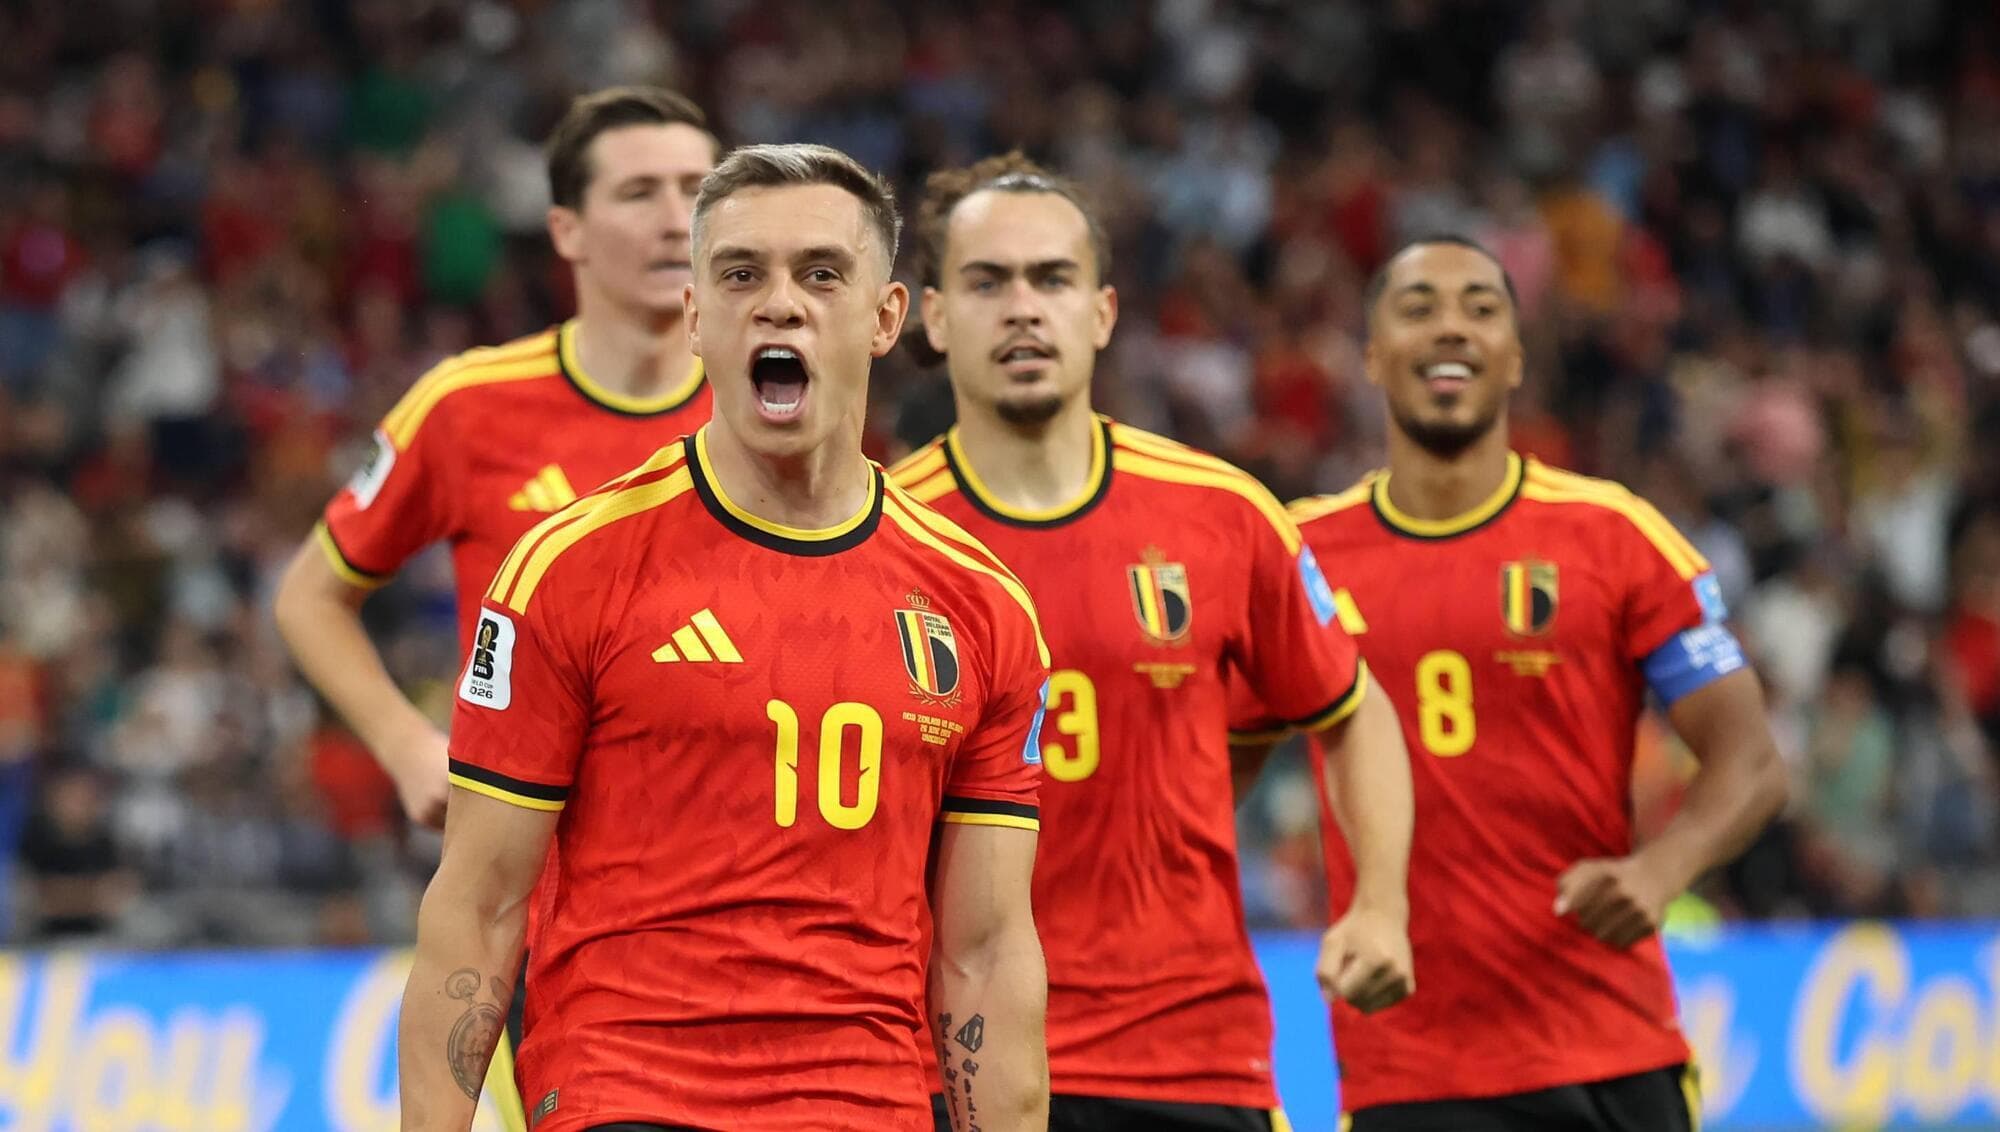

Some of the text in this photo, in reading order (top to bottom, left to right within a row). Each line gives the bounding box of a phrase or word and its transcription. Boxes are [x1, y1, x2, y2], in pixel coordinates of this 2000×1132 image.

[469, 686, 493, 699] 026
[1043, 669, 1099, 782] 3
[1415, 649, 1476, 757] 8
[766, 698, 883, 830] 10
